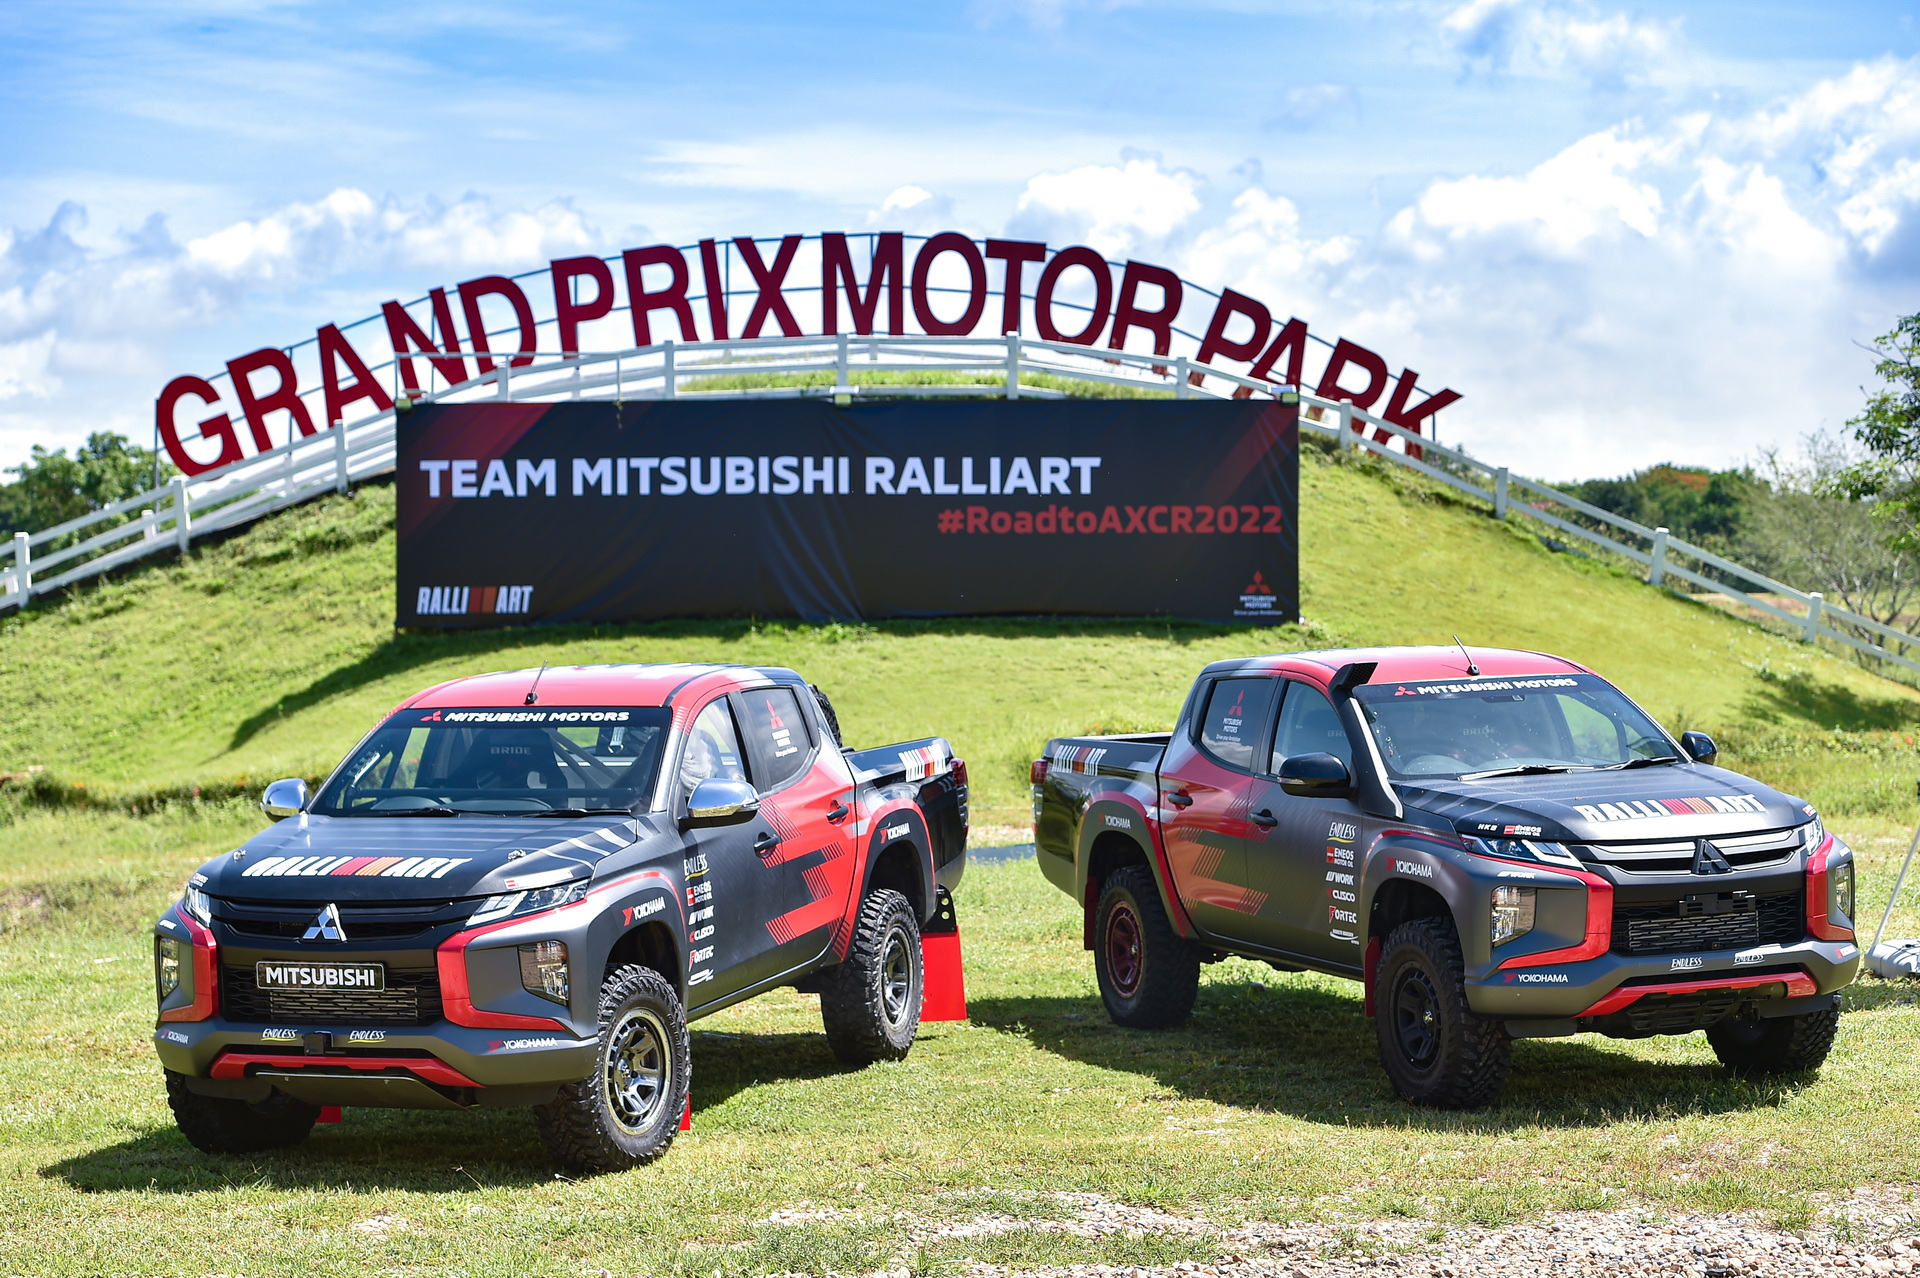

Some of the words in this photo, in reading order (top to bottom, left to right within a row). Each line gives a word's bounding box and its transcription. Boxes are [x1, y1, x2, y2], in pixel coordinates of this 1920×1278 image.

[157, 276, 537, 477] GRAND
[550, 234, 802, 359] PRIX
[822, 232, 1182, 374] MOTOR
[1189, 287, 1464, 461] PARK
[420, 458, 557, 498] TEAM
[572, 456, 850, 497] MITSUBISHI
[864, 456, 1102, 495] RALLIART
[937, 504, 1283, 534] #RoadtoAXCR2022
[1417, 681, 1513, 695] MITSUBISHI
[1512, 678, 1578, 689] MOTORS
[444, 712, 547, 722] MITSUBISHI
[548, 711, 630, 722] MOTORS
[490, 746, 531, 756] BRIDE
[1328, 821, 1357, 839] ENDLESS
[1515, 824, 1542, 833] ENEOS
[1334, 847, 1354, 860] ENEOS
[1396, 859, 1433, 878] YOKOHAMA
[1334, 872, 1354, 886] WORK
[1332, 889, 1356, 902] CUSCO
[632, 896, 666, 920] YOKOHAMA
[1329, 905, 1357, 924] FORTEC
[694, 924, 715, 941] CUSCO
[1671, 956, 1702, 968] ENDLESS
[265, 966, 375, 986] MITSUBISHI
[1518, 974, 1569, 983] YOKOHAMA
[262, 1028, 297, 1039] ENDLESS
[349, 1030, 386, 1040] ENDLESS
[503, 1037, 558, 1050] YOKOHAMA
